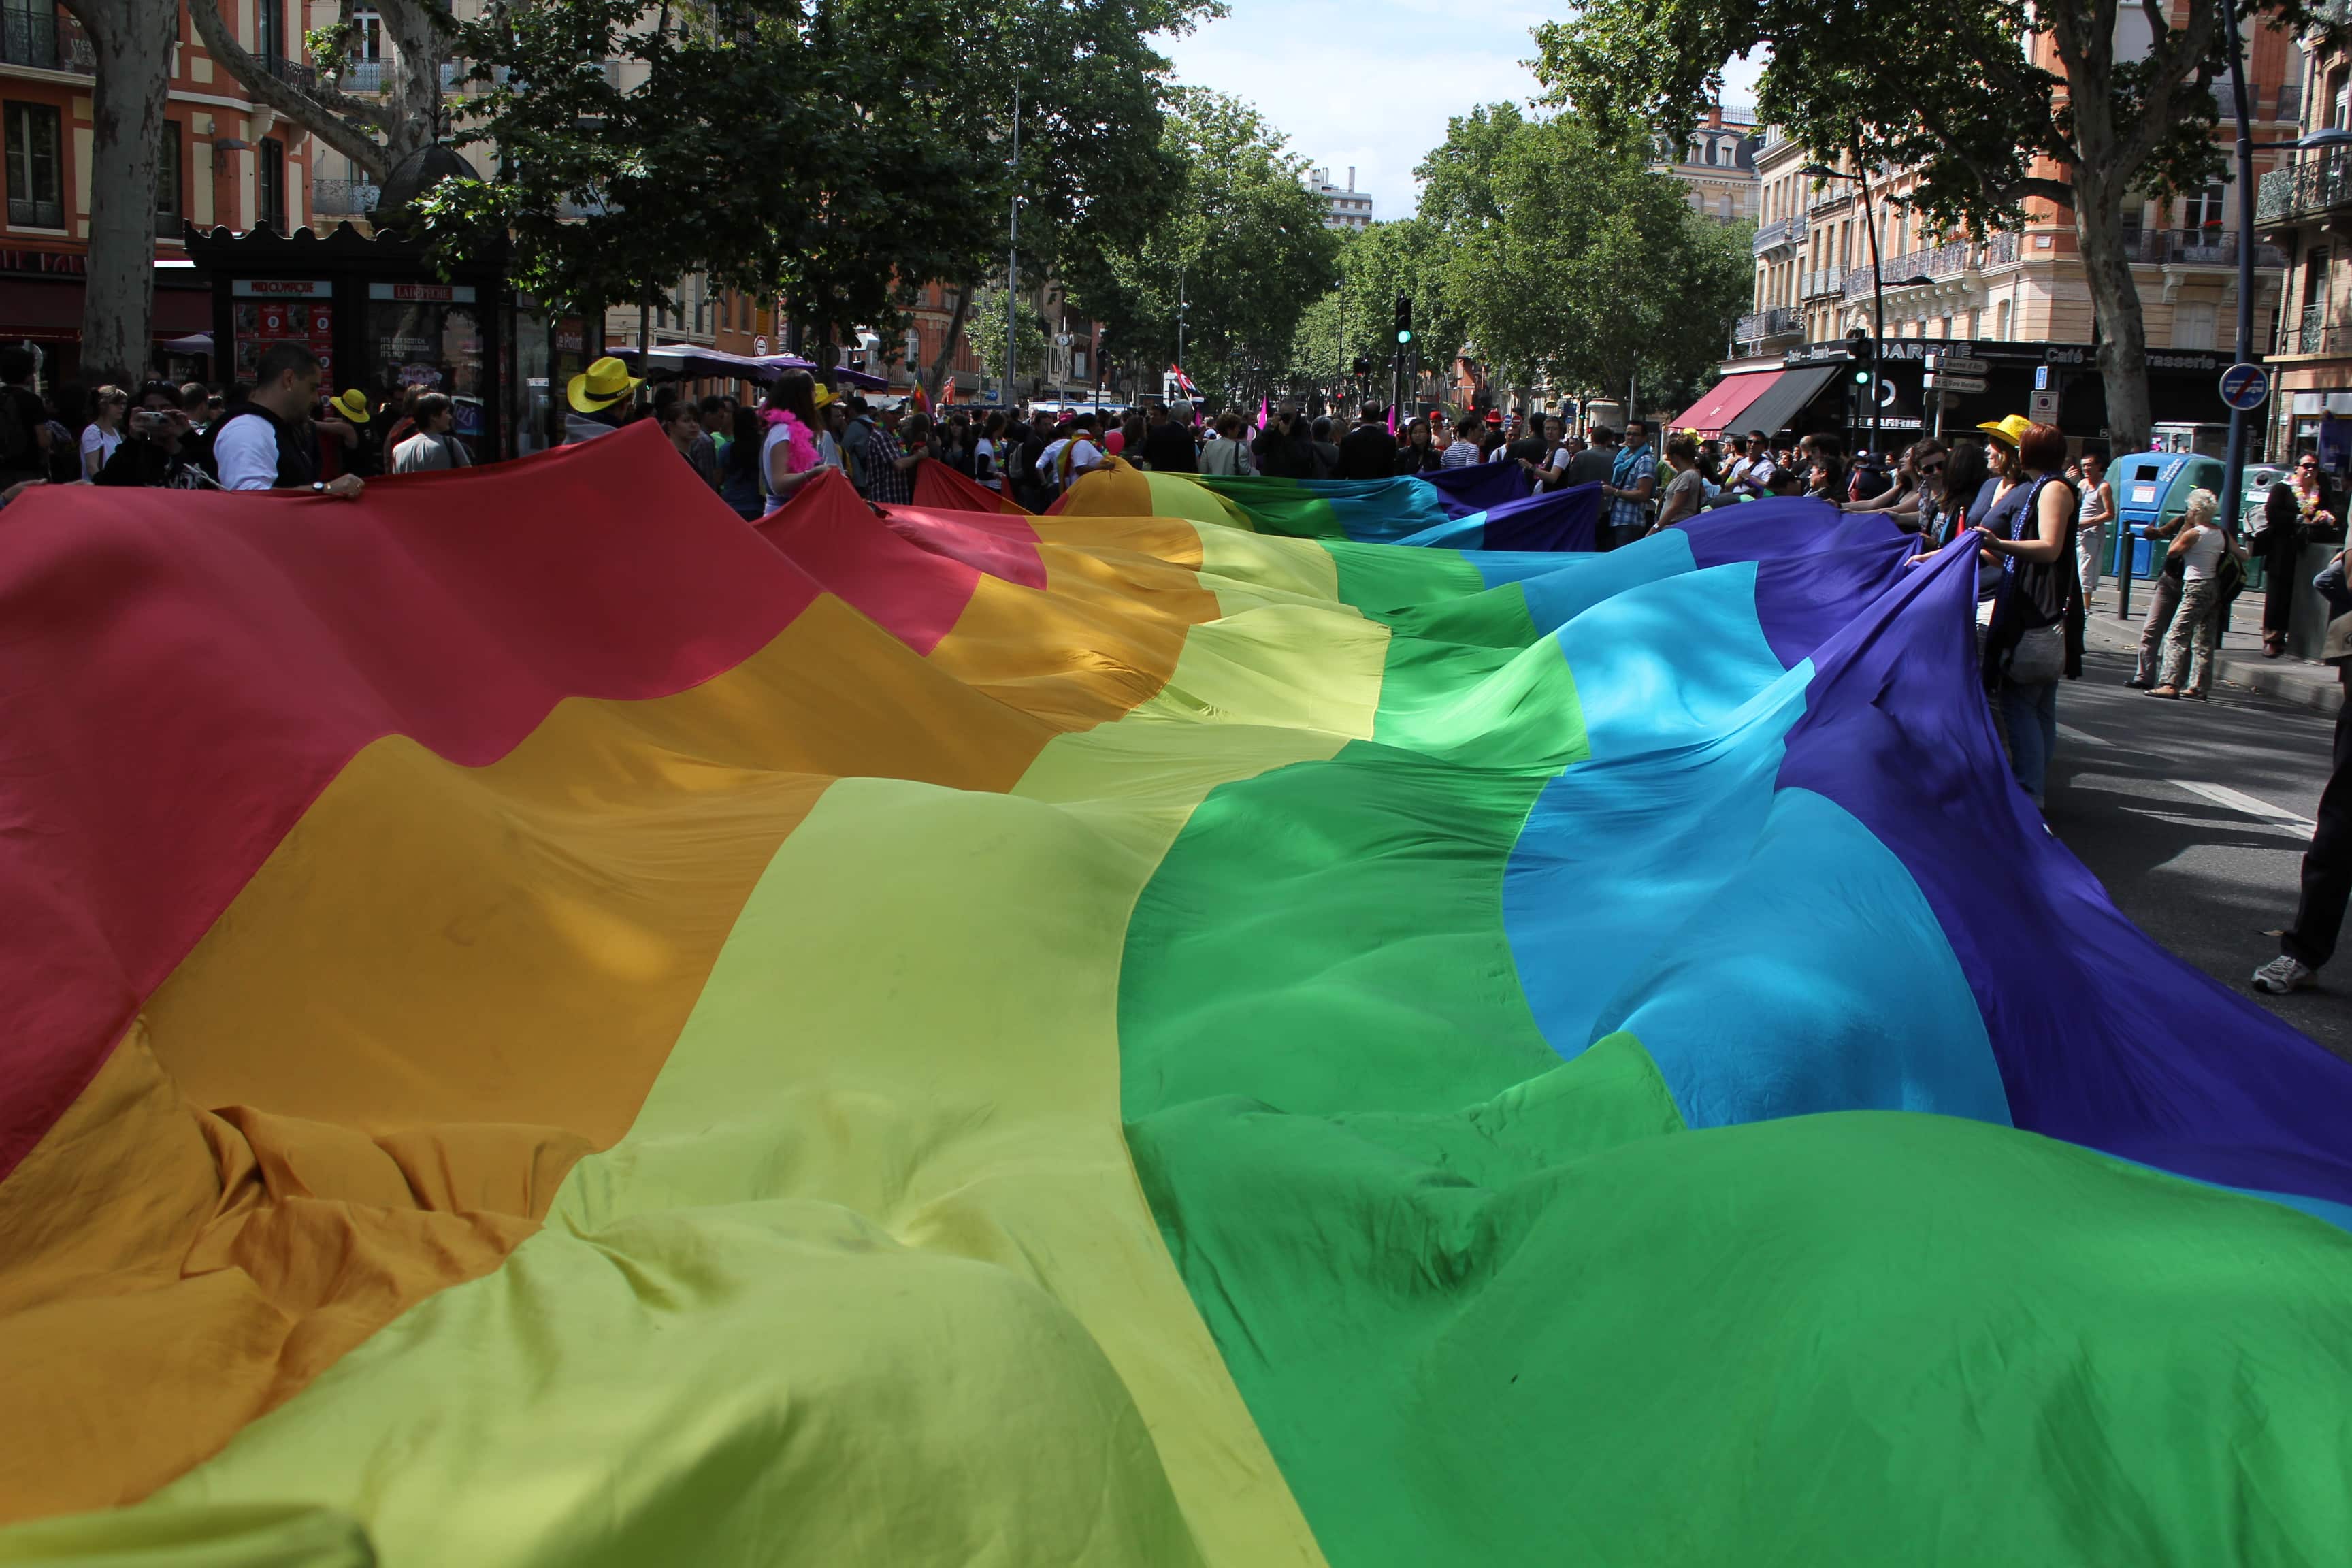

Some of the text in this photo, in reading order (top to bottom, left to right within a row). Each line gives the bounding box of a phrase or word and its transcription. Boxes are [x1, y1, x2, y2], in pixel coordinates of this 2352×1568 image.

[556, 332, 583, 350] Le Point
[2044, 347, 2085, 364] Café
[2145, 353, 2216, 370] rasserie
